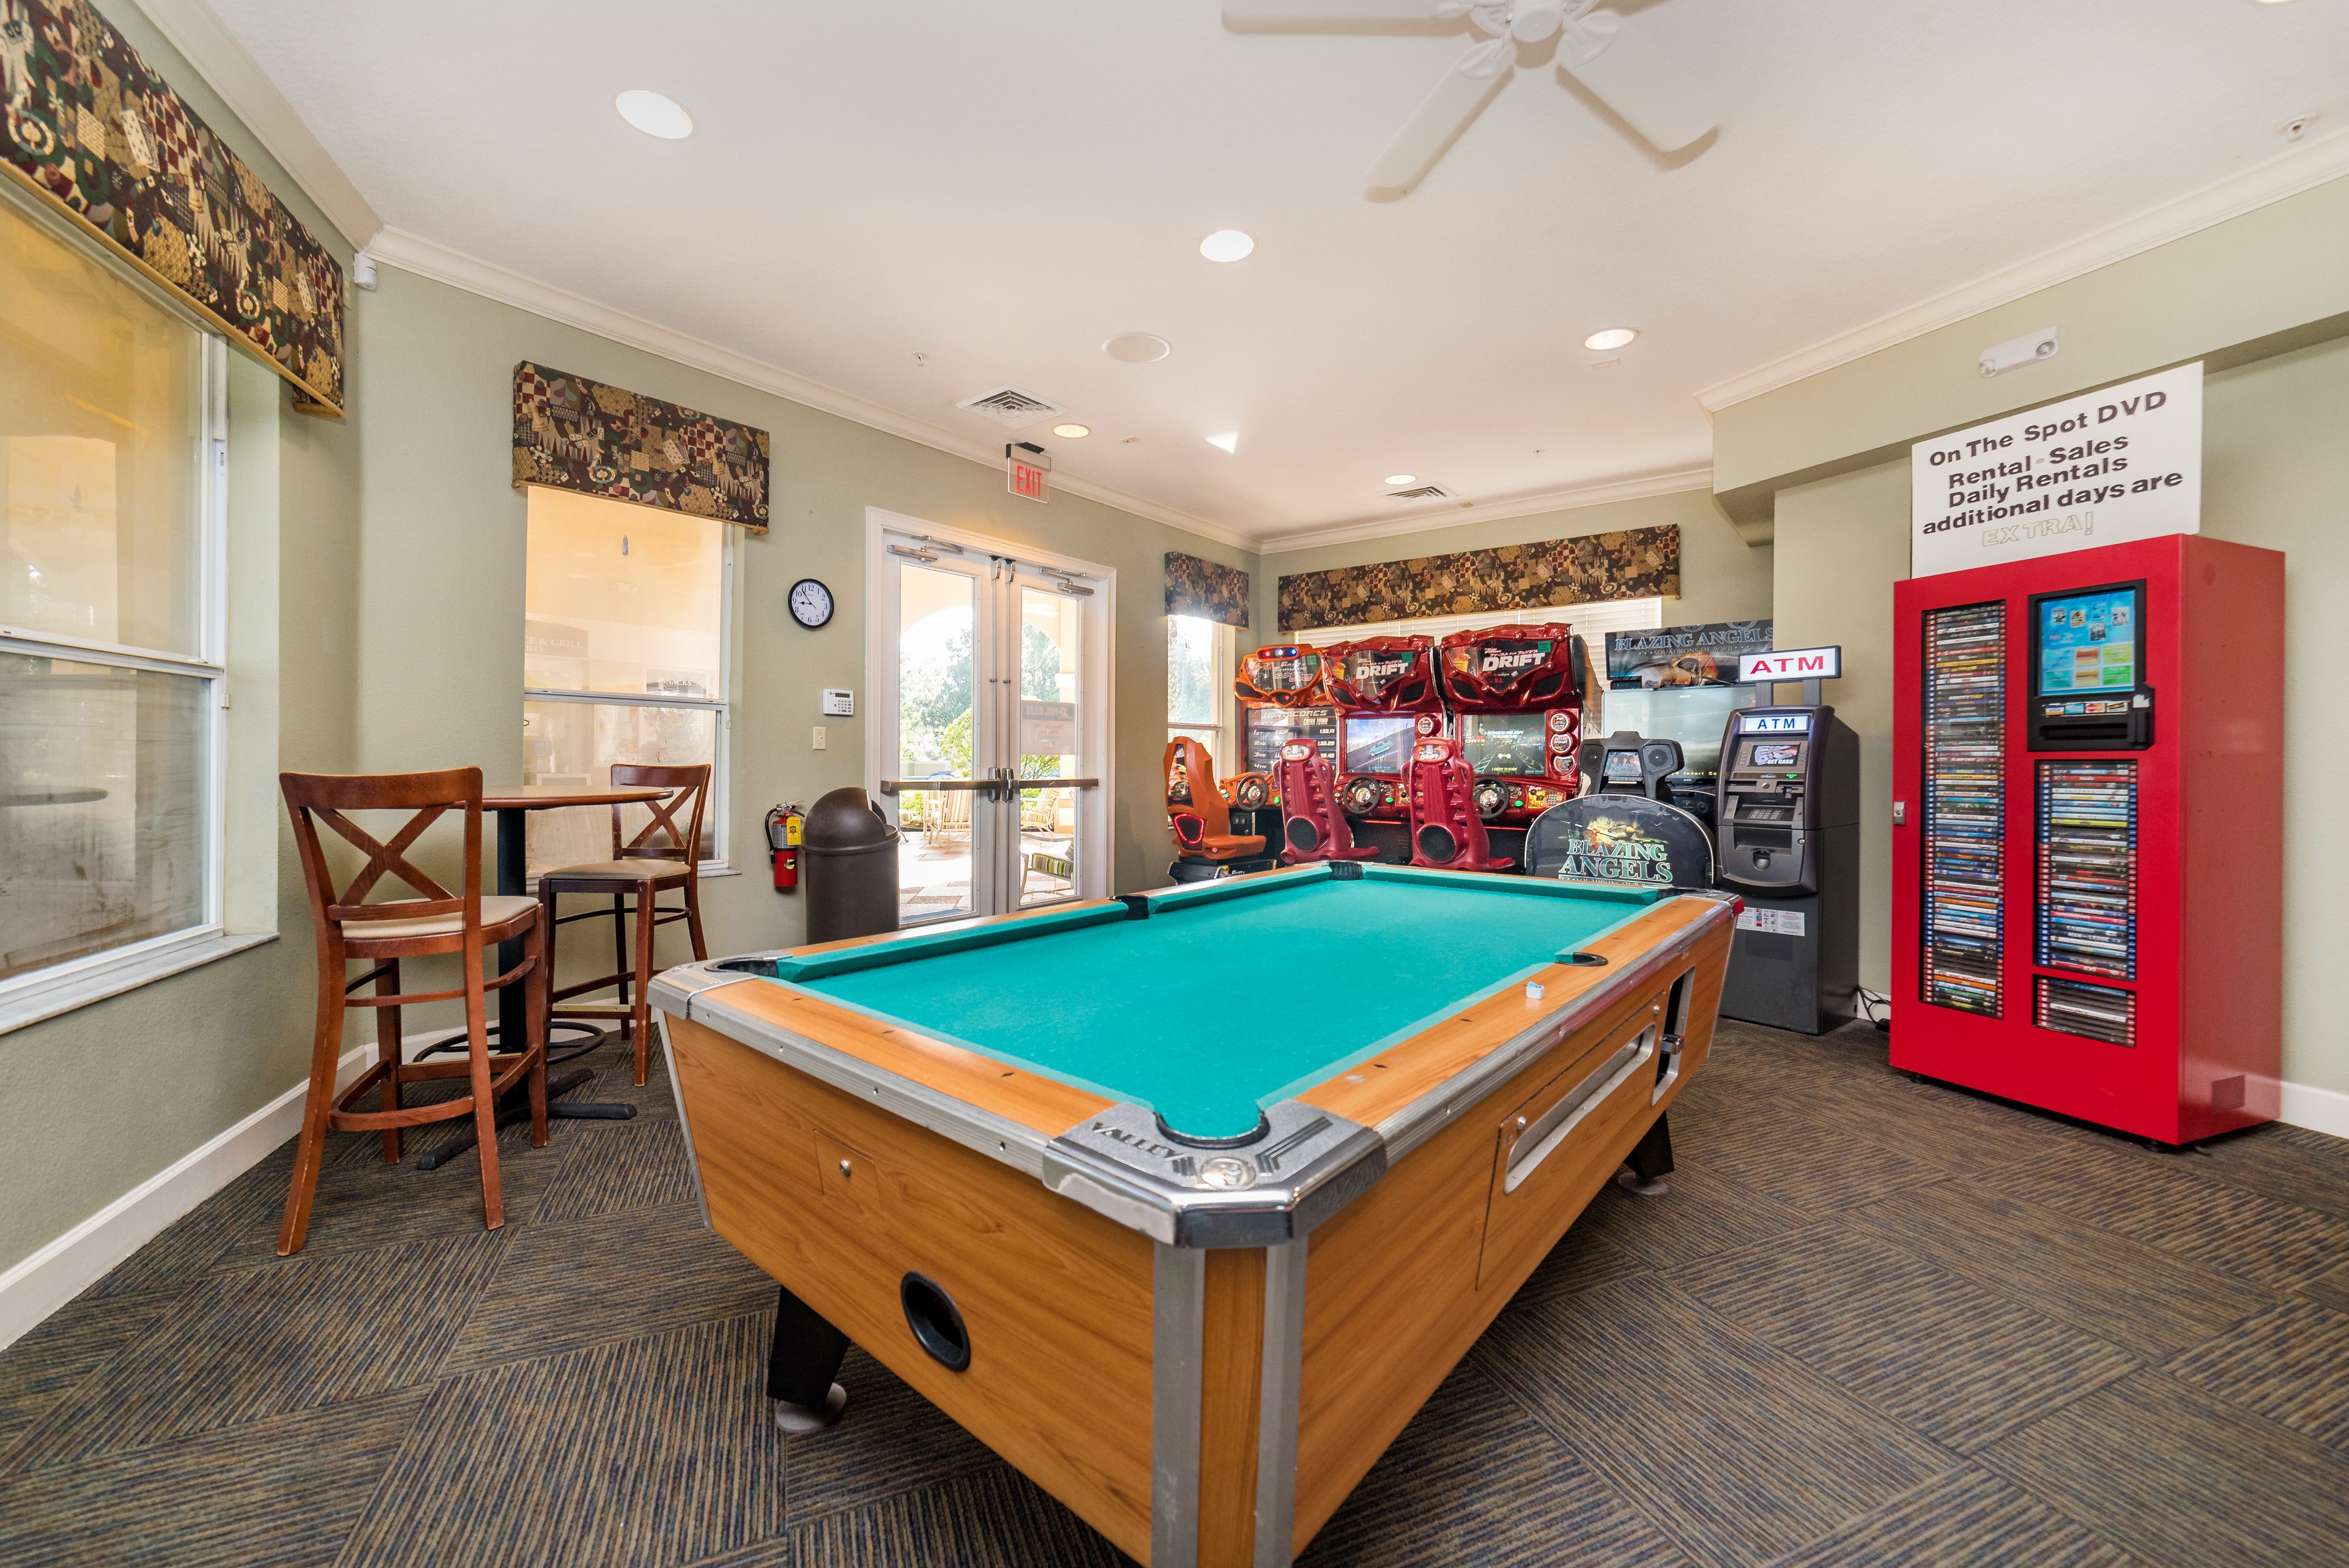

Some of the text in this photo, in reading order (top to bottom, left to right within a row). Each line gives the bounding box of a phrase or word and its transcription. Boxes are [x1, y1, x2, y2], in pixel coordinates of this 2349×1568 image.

[1929, 391, 2167, 467] On The Spot DVD
[1948, 455, 2031, 489] Rental
[2049, 435, 2129, 465] Sales
[1016, 464, 1042, 498] EXIT
[1948, 455, 2129, 508] Daily Rentals
[1922, 472, 2183, 535] additional days are
[1982, 511, 2093, 548] EXTRA!
[551, 639, 583, 648] GRILL
[1614, 627, 1773, 652] BLAZING ANGELS
[1356, 663, 1409, 680] DRIFT
[1482, 652, 1545, 672] DRIFT
[1750, 655, 1824, 674] ATM
[1757, 718, 1795, 730] ATM
[1567, 839, 1668, 861] BLAZING
[1558, 855, 1674, 883] ANGELS
[1093, 1121, 1188, 1161] VALLEY
